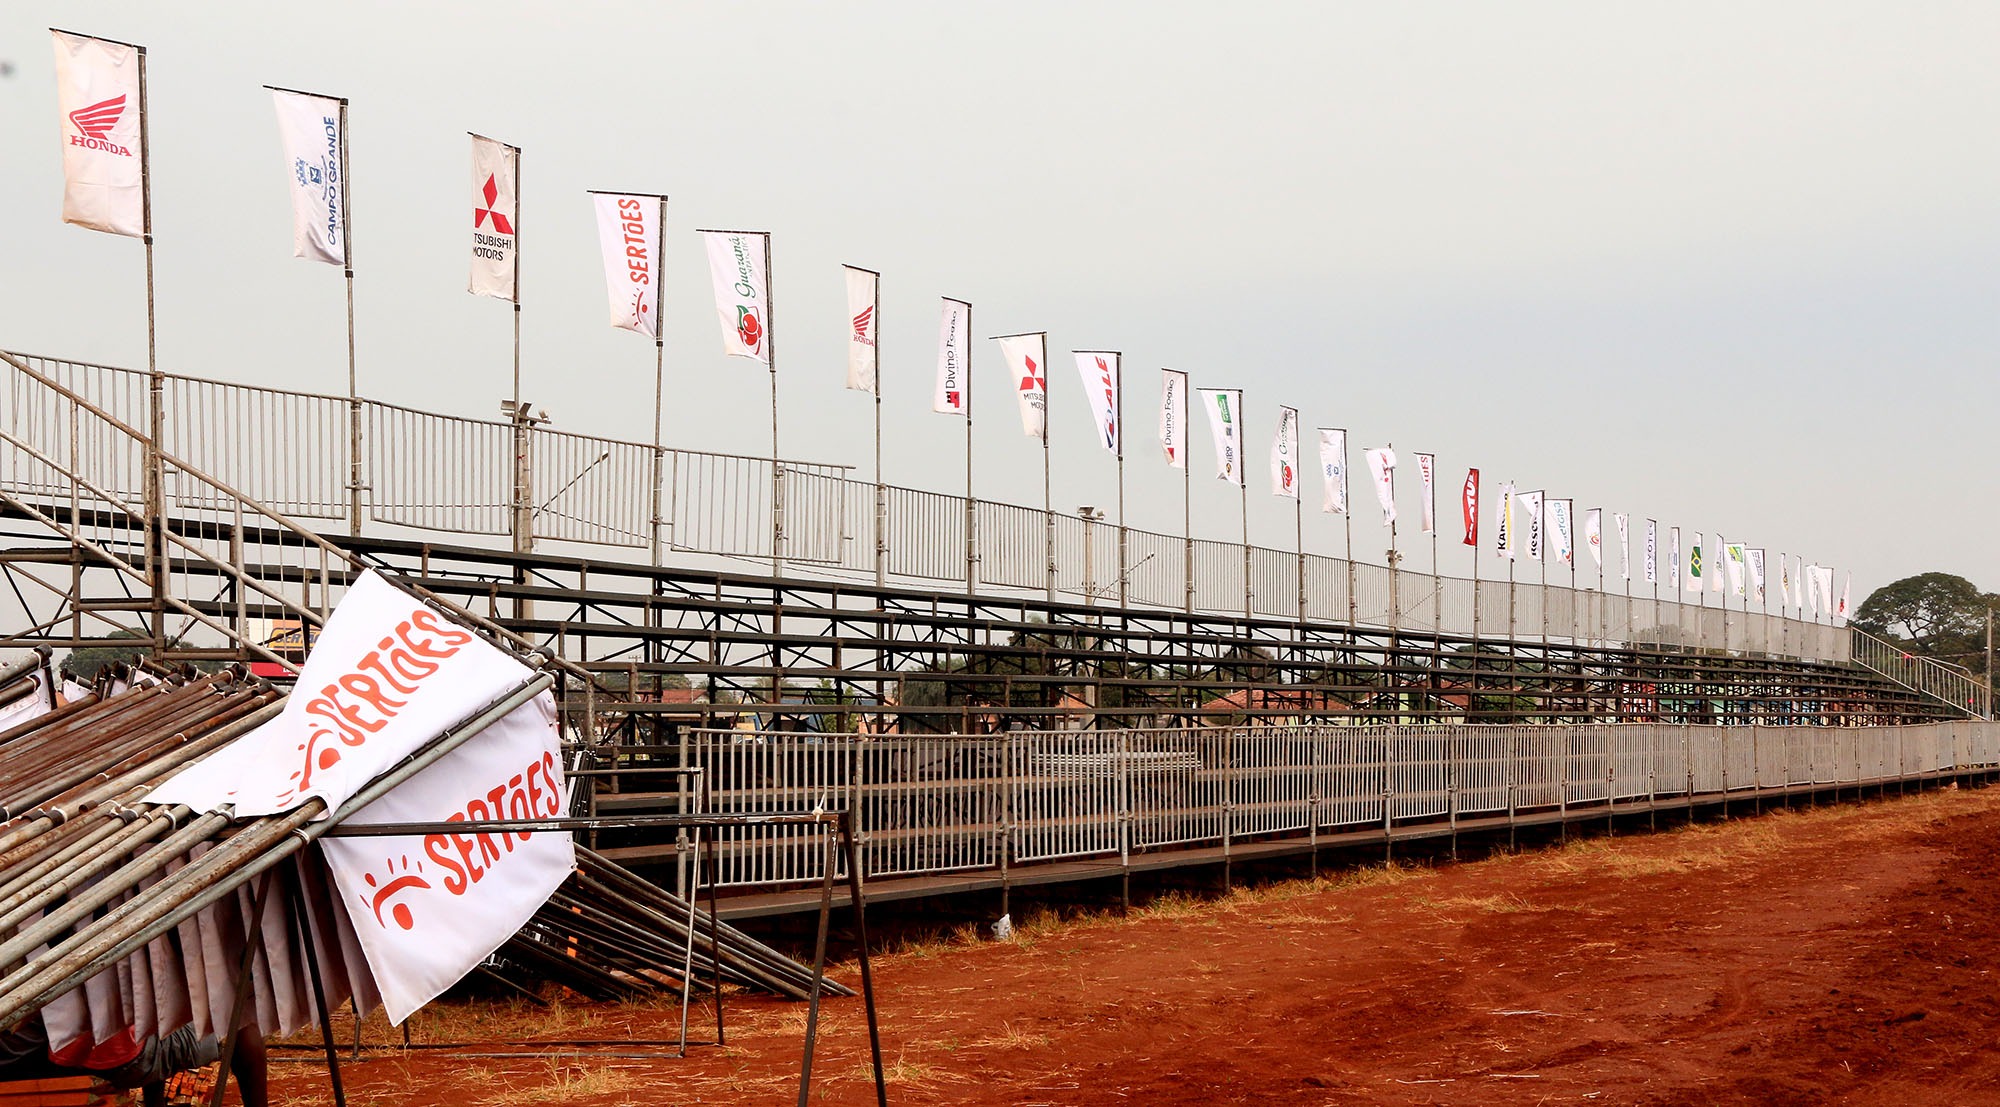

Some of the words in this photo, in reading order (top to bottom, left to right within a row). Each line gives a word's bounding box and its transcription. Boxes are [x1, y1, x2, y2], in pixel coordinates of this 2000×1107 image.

[70, 135, 132, 157] HONDA
[323, 116, 336, 183] GRANDE
[327, 184, 337, 245] CAMPO
[853, 334, 874, 347] HONDA
[945, 351, 956, 389] Divino
[1095, 355, 1113, 410] ALE
[1165, 379, 1174, 411] Fogão
